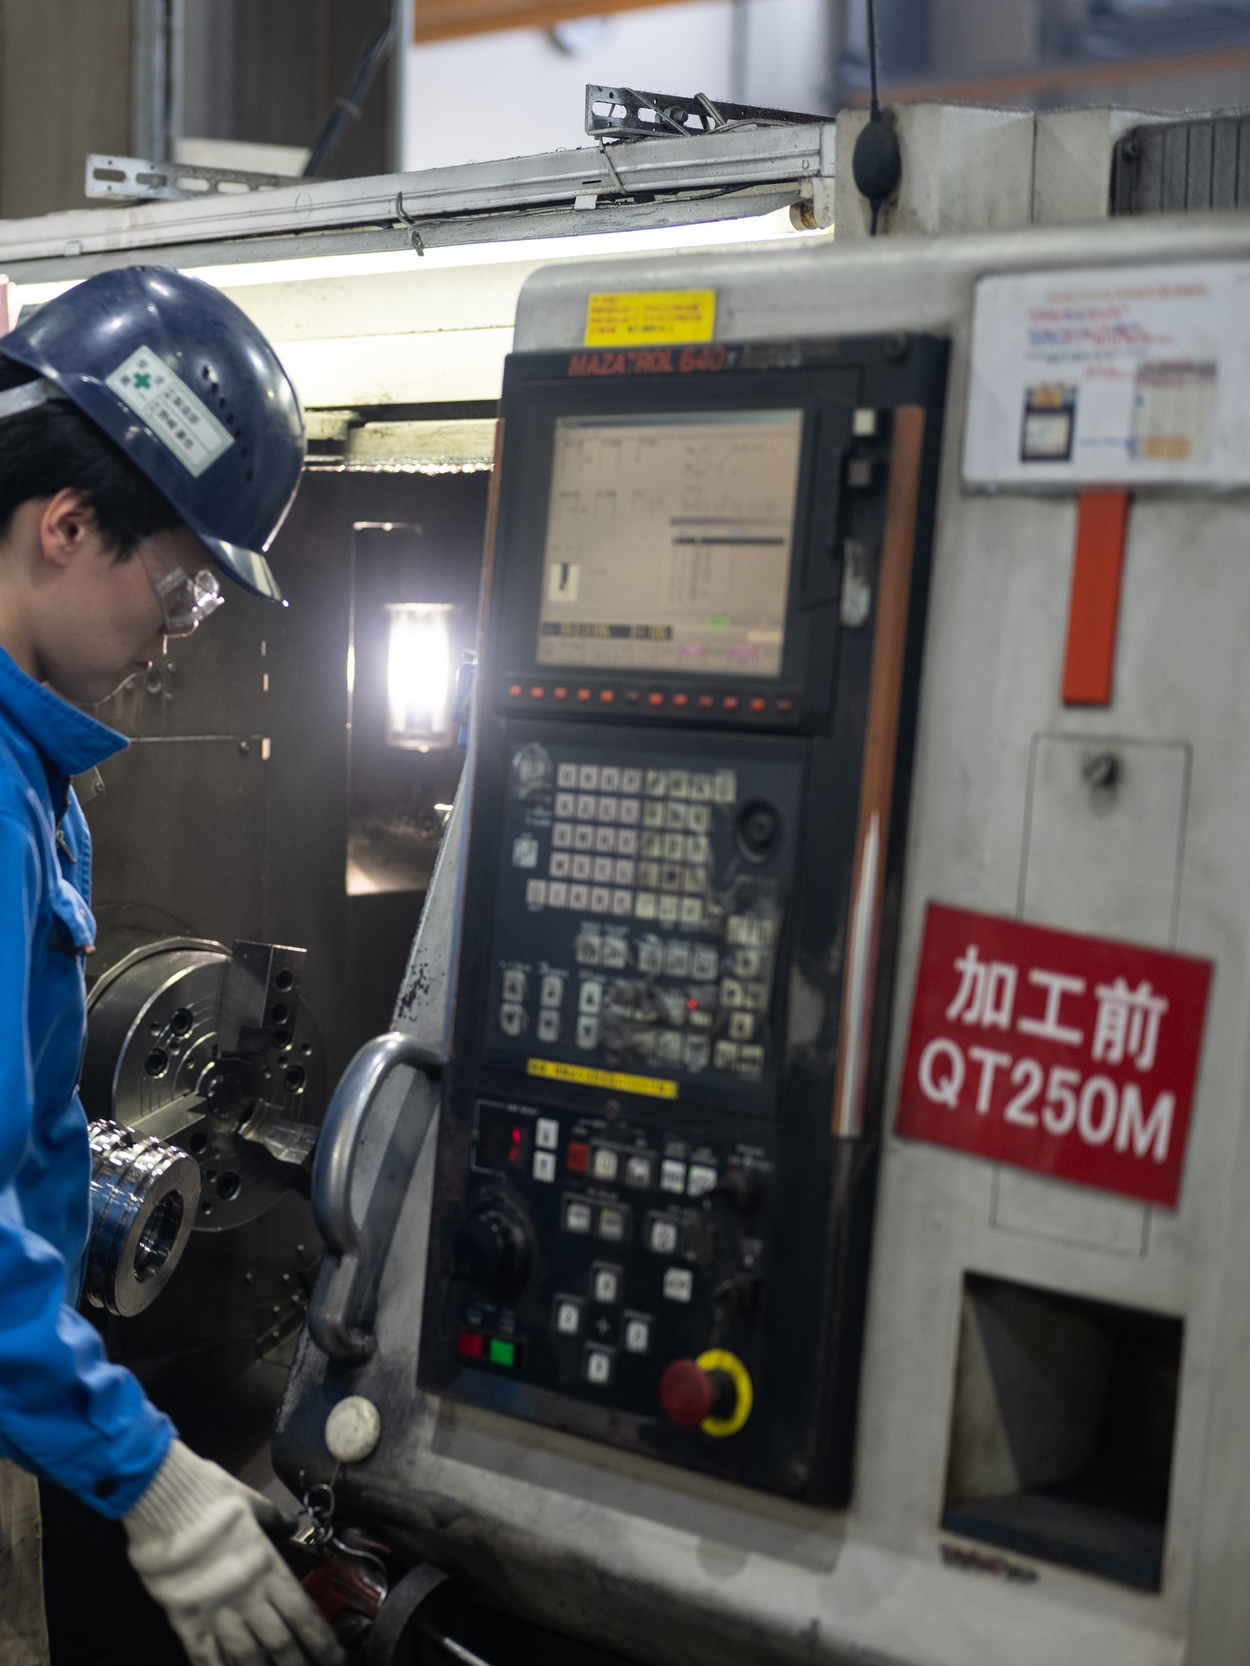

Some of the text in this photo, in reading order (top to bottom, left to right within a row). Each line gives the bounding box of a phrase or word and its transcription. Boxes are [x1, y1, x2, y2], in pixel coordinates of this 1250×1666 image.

[946, 944, 1169, 1072] 加工前
[917, 1037, 1176, 1165] QT250M
